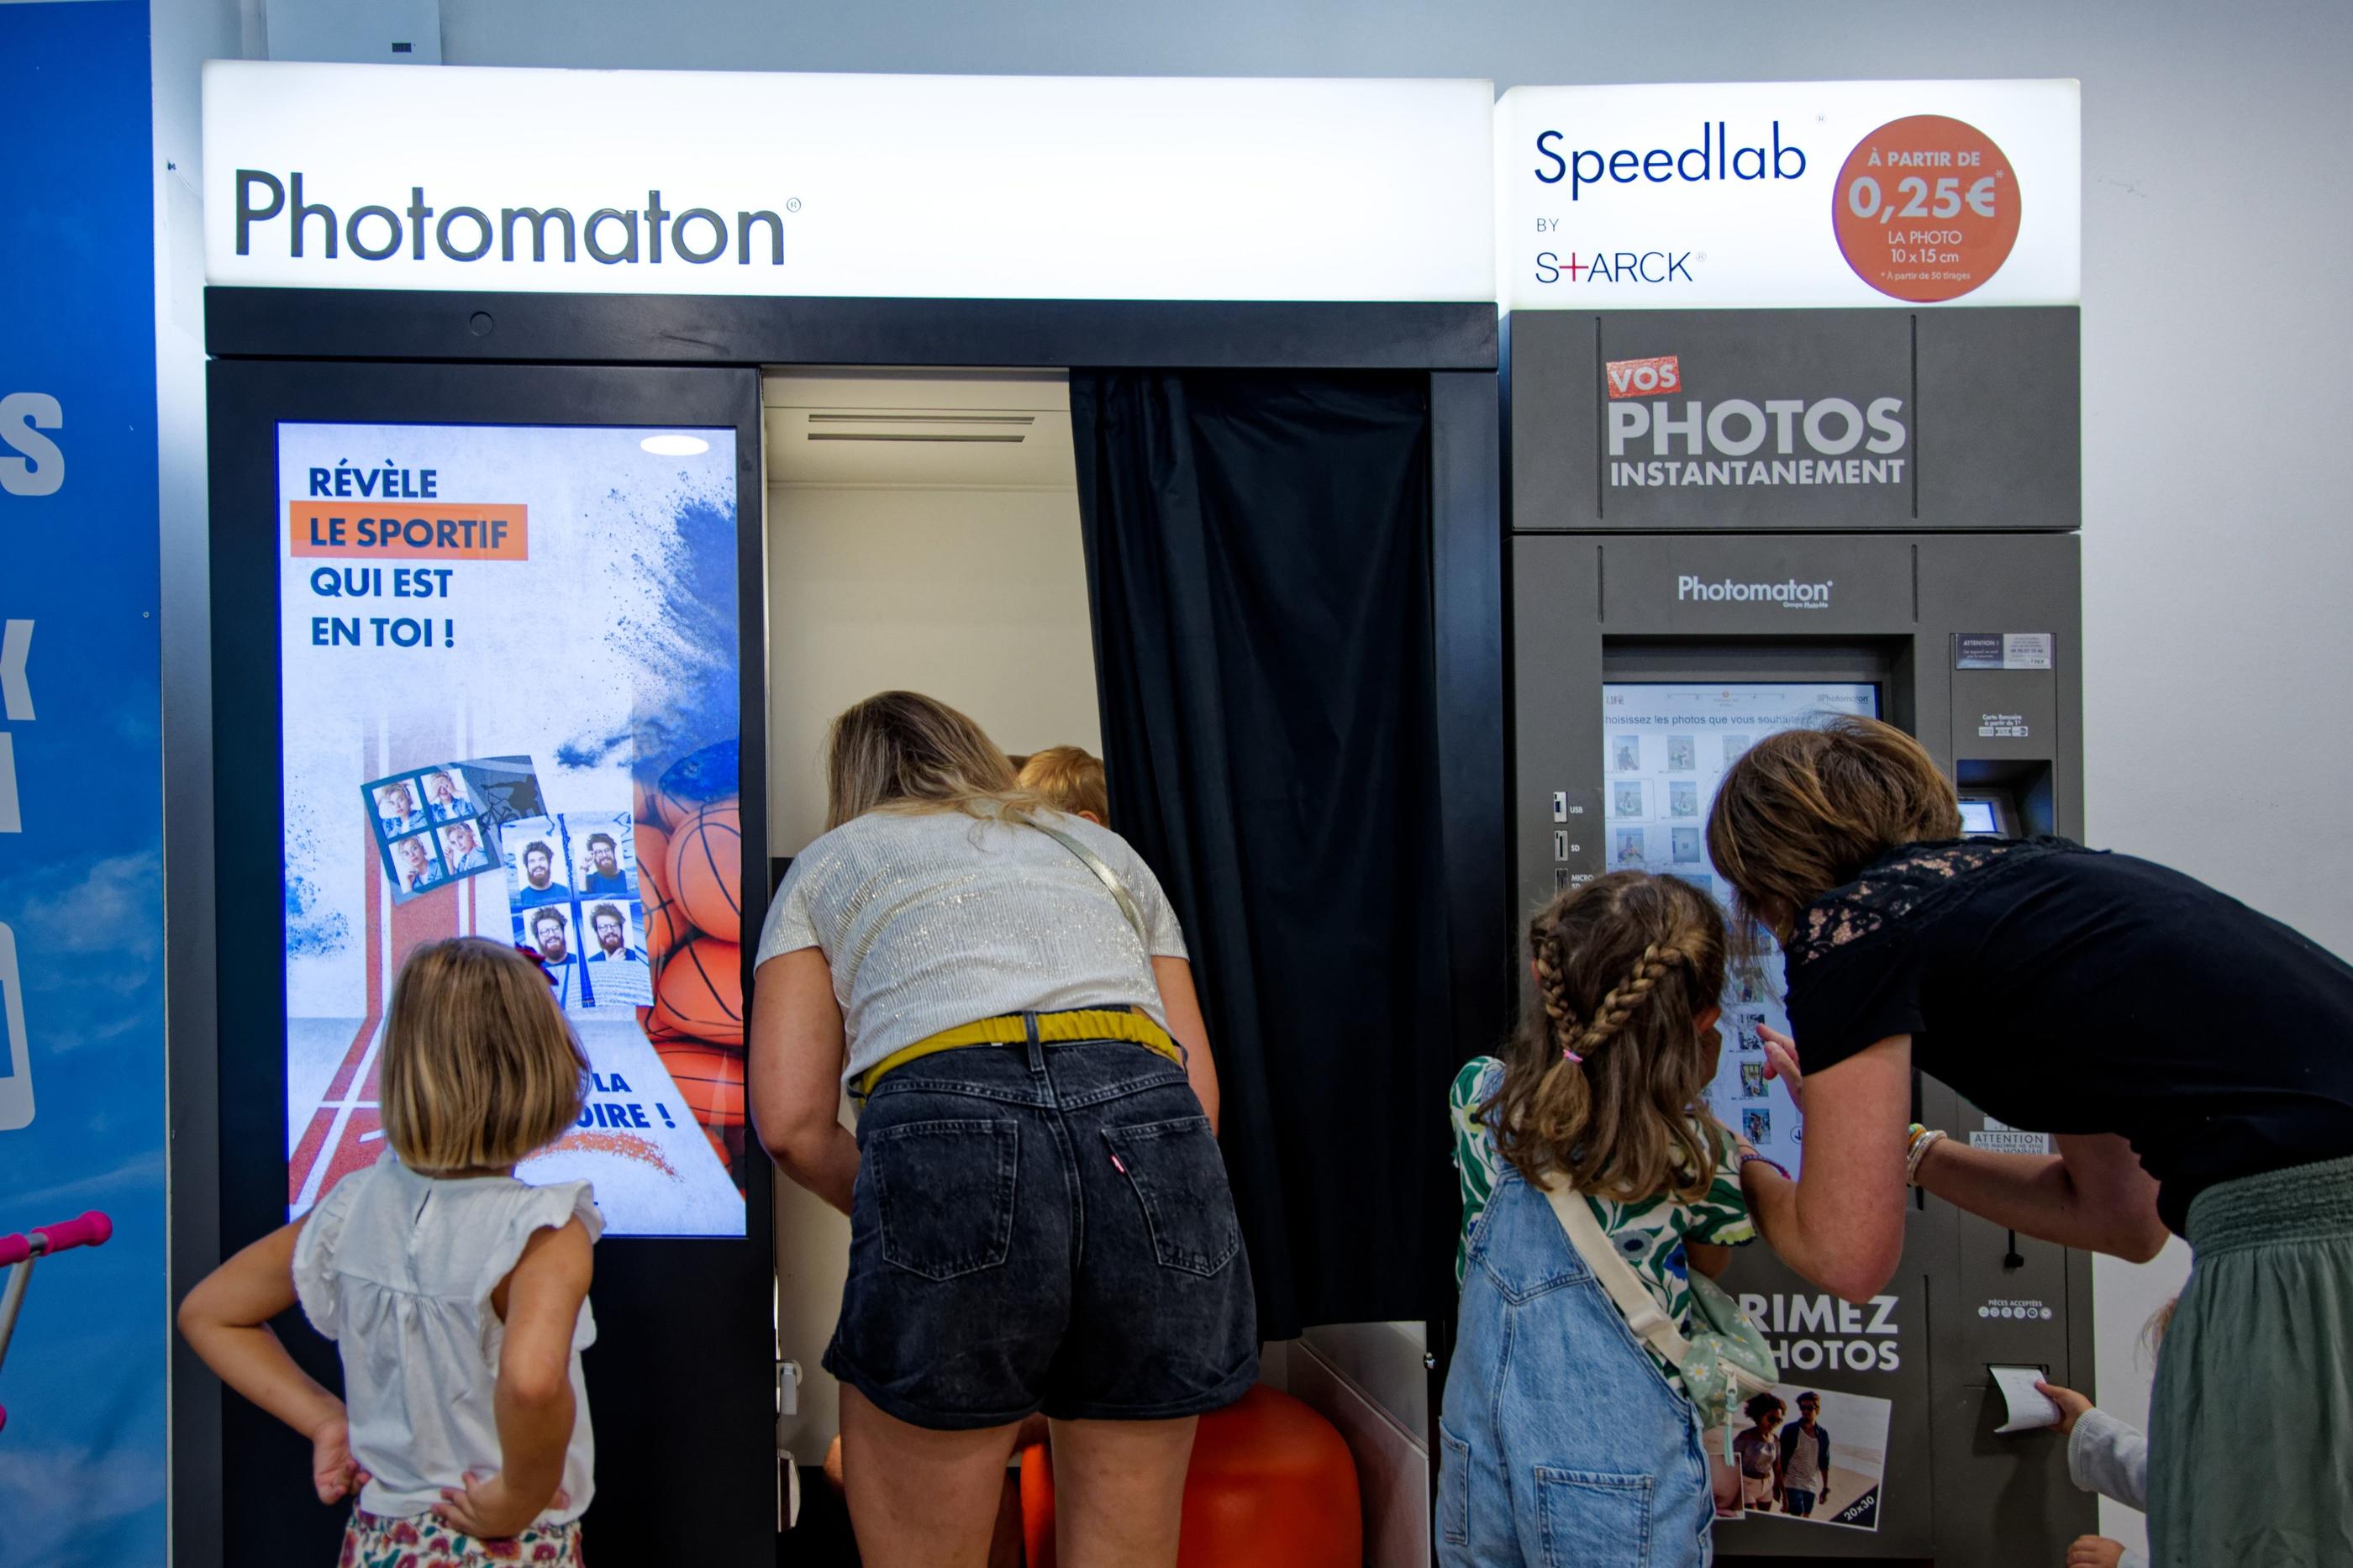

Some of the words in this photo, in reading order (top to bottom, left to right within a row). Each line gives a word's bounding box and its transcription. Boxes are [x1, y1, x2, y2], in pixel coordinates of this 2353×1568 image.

[1534, 121, 1806, 201] Speedlab
[1867, 147, 1882, 166] À
[1887, 151, 1951, 166] PARTIR
[1957, 151, 1981, 166] DE
[236, 169, 784, 265] Photomaton
[1536, 218, 1560, 232] BY
[1888, 230, 1905, 245] LA
[1910, 230, 1962, 245] PHOTO
[1892, 249, 1906, 263] 10
[1909, 254, 1917, 263] x
[1920, 249, 1935, 263] 15
[1940, 253, 1959, 263] cm
[1895, 271, 1917, 282] partir
[1919, 271, 1929, 280] de
[1943, 271, 1971, 282] tirages
[1609, 363, 1677, 393] VOS
[1608, 397, 1906, 456] PHOTOS
[309, 458, 437, 497] RÉVÈLE
[1610, 459, 1905, 487] INSTANTANEMENT
[310, 518, 346, 546] LE
[356, 518, 508, 549] SPORTIF
[310, 566, 382, 597] QUI
[393, 568, 453, 597] EST
[1678, 576, 1830, 601] Photomaton
[312, 617, 361, 645] EN
[370, 618, 432, 647] TOI
[1605, 715, 1651, 724] hoisissez
[1655, 715, 1669, 724] les
[1672, 715, 1706, 726] photos
[1708, 717, 1728, 726] que
[1571, 874, 1594, 882] MICRO
[592, 1072, 632, 1092] LA
[576, 1103, 651, 1129] OIRE
[1974, 1134, 2044, 1144] ATTENTION
[1739, 1293, 1899, 1334] RIMEZ
[1766, 1339, 1900, 1371] HOTOS
[1843, 1495, 1875, 1521] 20x30
